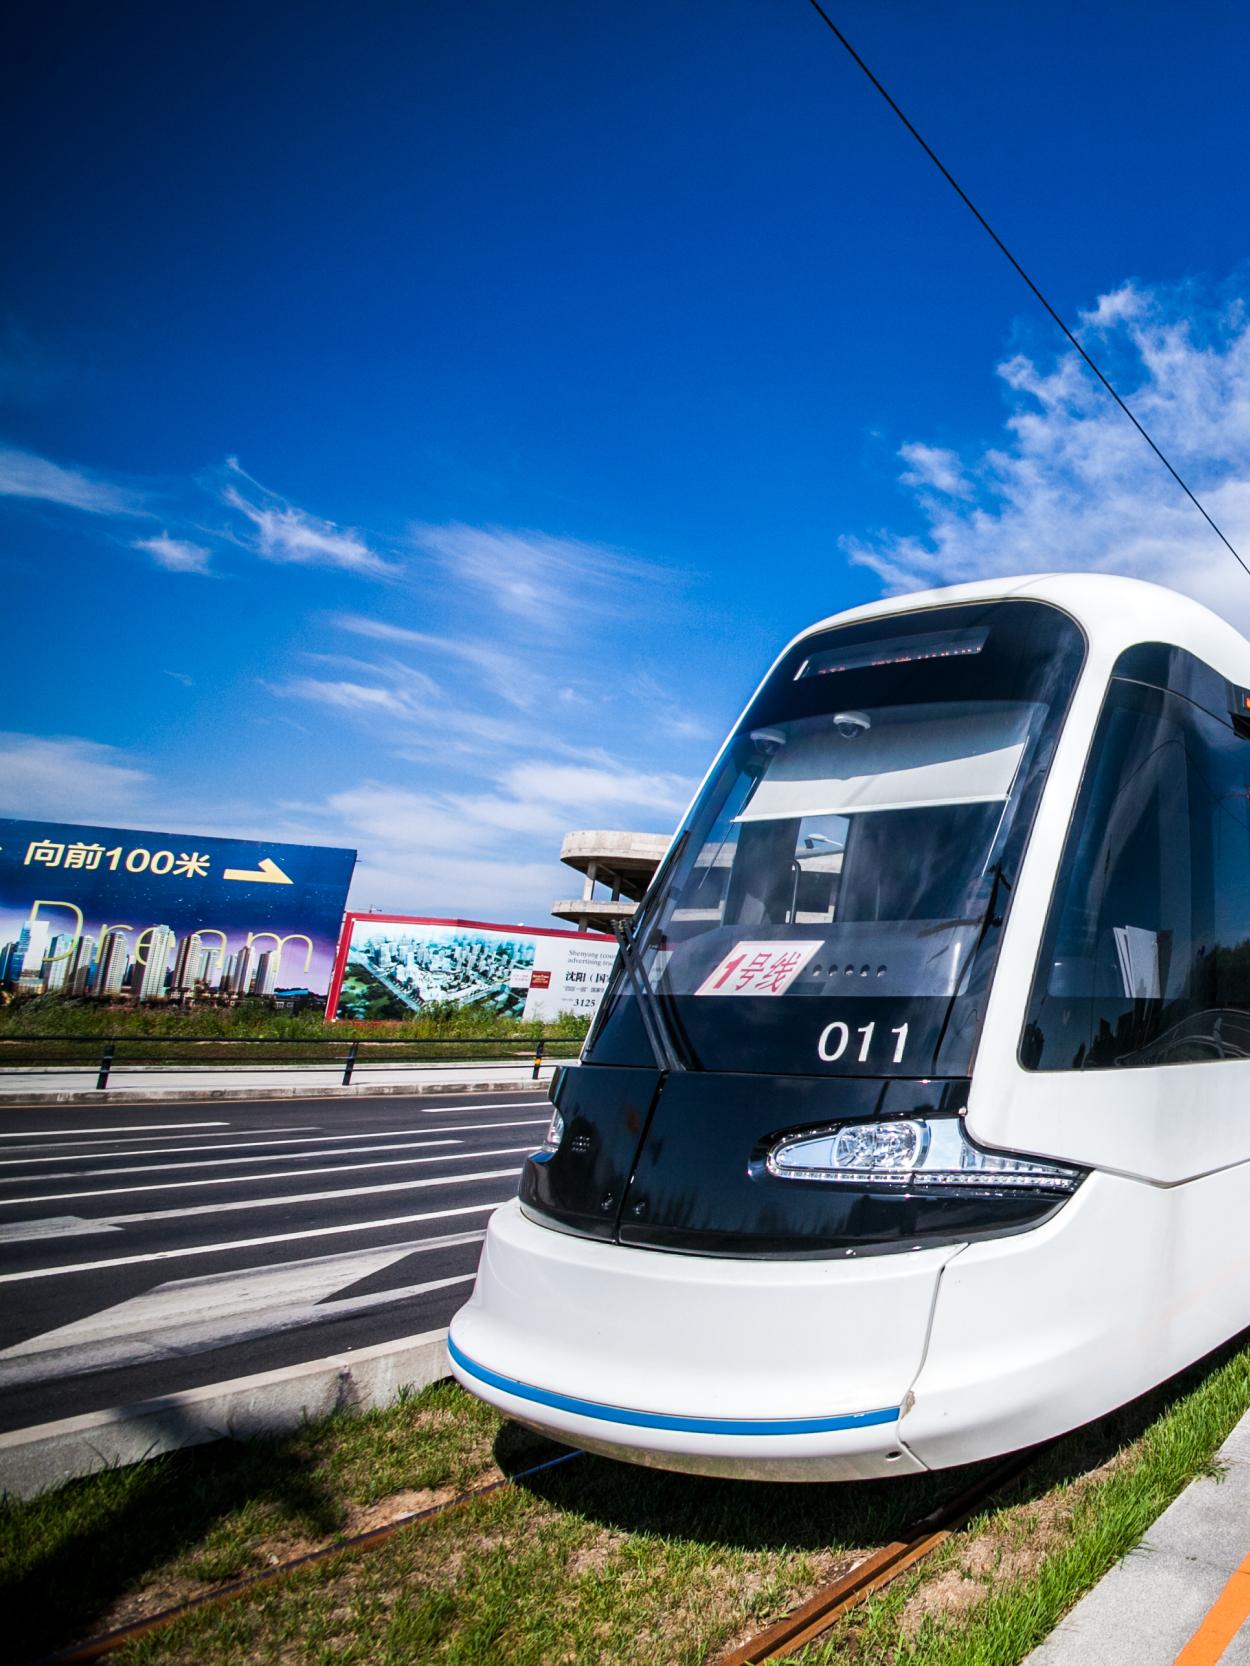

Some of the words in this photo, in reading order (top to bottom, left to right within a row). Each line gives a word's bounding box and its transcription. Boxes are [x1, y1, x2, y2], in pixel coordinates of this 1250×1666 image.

[24, 839, 210, 878] 向前100米
[29, 900, 314, 973] Dream
[713, 952, 801, 992] 1号线
[573, 998, 596, 1008] 3125
[817, 1021, 909, 1063] 011
